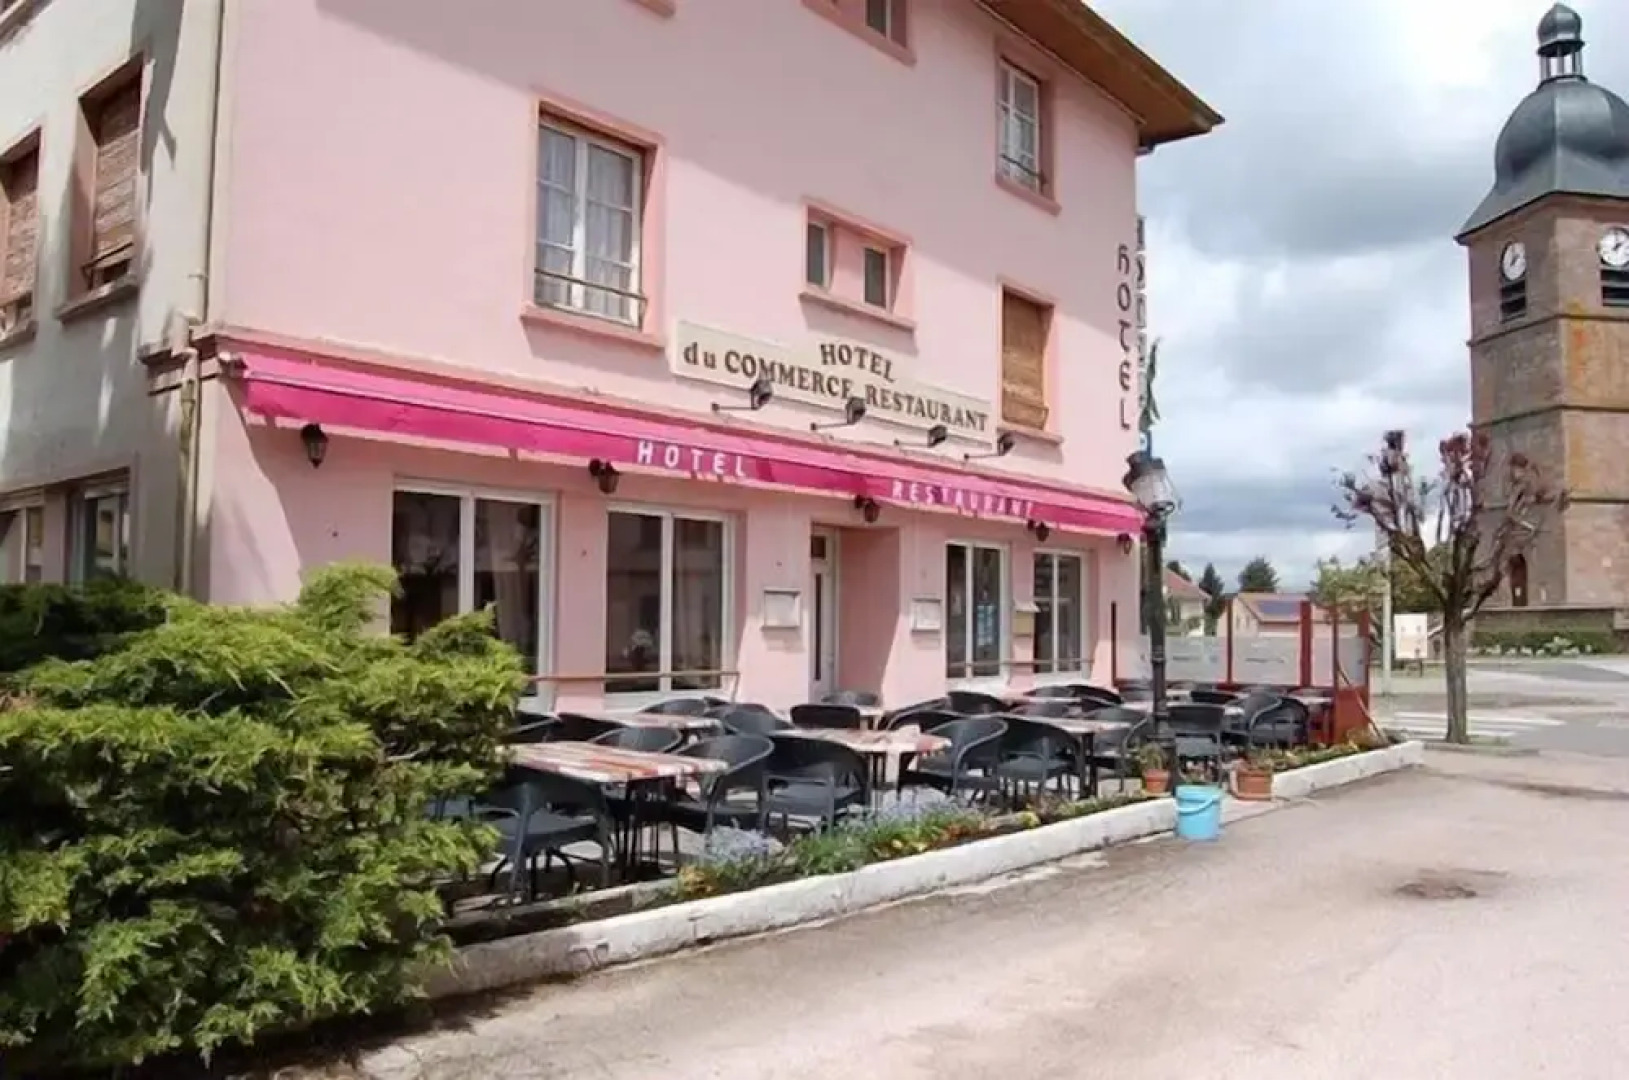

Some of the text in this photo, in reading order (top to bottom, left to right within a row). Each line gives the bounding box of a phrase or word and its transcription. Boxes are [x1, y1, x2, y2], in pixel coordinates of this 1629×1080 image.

[819, 343, 895, 382] HOTEL
[683, 341, 989, 432] du COMMERCE RESTAURANT
[637, 440, 747, 477] HOTEL
